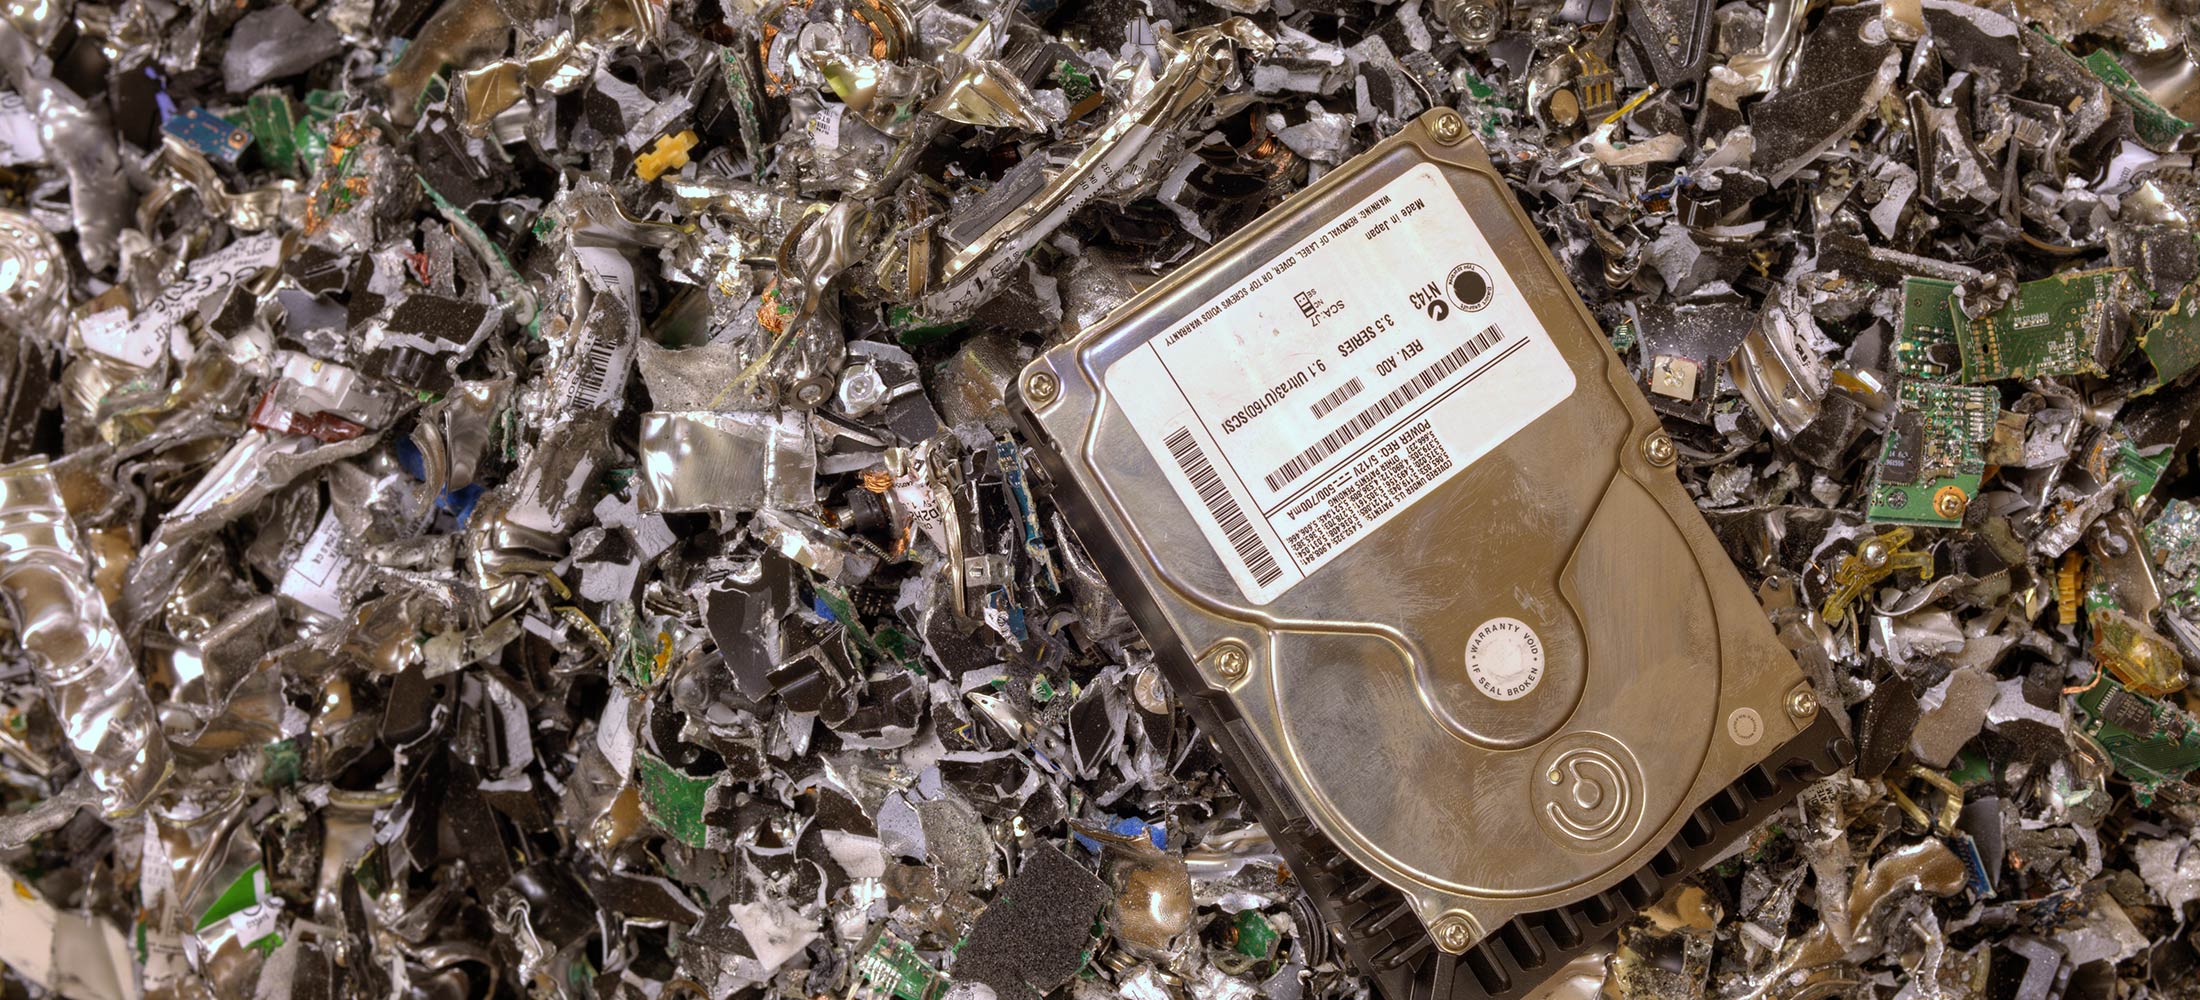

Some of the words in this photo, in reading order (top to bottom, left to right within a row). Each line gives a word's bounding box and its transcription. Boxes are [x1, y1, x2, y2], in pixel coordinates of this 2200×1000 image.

[1357, 195, 1392, 219] WARNING:
[1400, 198, 1425, 217] Made
[1327, 215, 1359, 239] REMOVAL
[1389, 213, 1402, 224] in
[1319, 234, 1330, 247] OF
[1365, 220, 1390, 241] Japan
[1295, 241, 1320, 258] LABEL,
[1271, 256, 1297, 275] COVER,
[1249, 278, 1263, 292] TOP
[1261, 271, 1274, 283] OR
[1220, 287, 1249, 309] SCREWS
[1306, 288, 1317, 299] SE
[1313, 298, 1324, 309] NC
[1409, 280, 1442, 310] N143
[1201, 305, 1223, 323] VOIDS
[1311, 299, 1345, 328] SCA:J7
[1374, 313, 1395, 333] 3.5
[1165, 318, 1203, 347] WARRANTY
[1337, 325, 1377, 358] SERIES
[1396, 338, 1424, 361] REV.
[1307, 359, 1327, 378] 9.1
[1376, 355, 1398, 377] A00
[1221, 371, 1309, 435] Ultra3(U160)SCSI
[1398, 418, 1432, 445] POWER
[1377, 439, 1401, 458] REQ:
[1352, 454, 1379, 478] 5/12V
[1379, 454, 1400, 472] OTHER
[1425, 459, 1453, 482] COVERED
[1354, 467, 1381, 489] PATENTS
[1405, 477, 1427, 496] UNDER
[1286, 483, 1337, 521] 500/700mA
[1327, 484, 1356, 508] PENDING
[1392, 491, 1407, 503] U.S.
[1365, 499, 1394, 522] PATENTS:
[1471, 623, 1520, 653] WARRANTY
[1523, 632, 1539, 655] VOID
[1472, 664, 1481, 673] IF
[1478, 676, 1502, 696] SEAL
[1507, 667, 1539, 696] BROKEN
